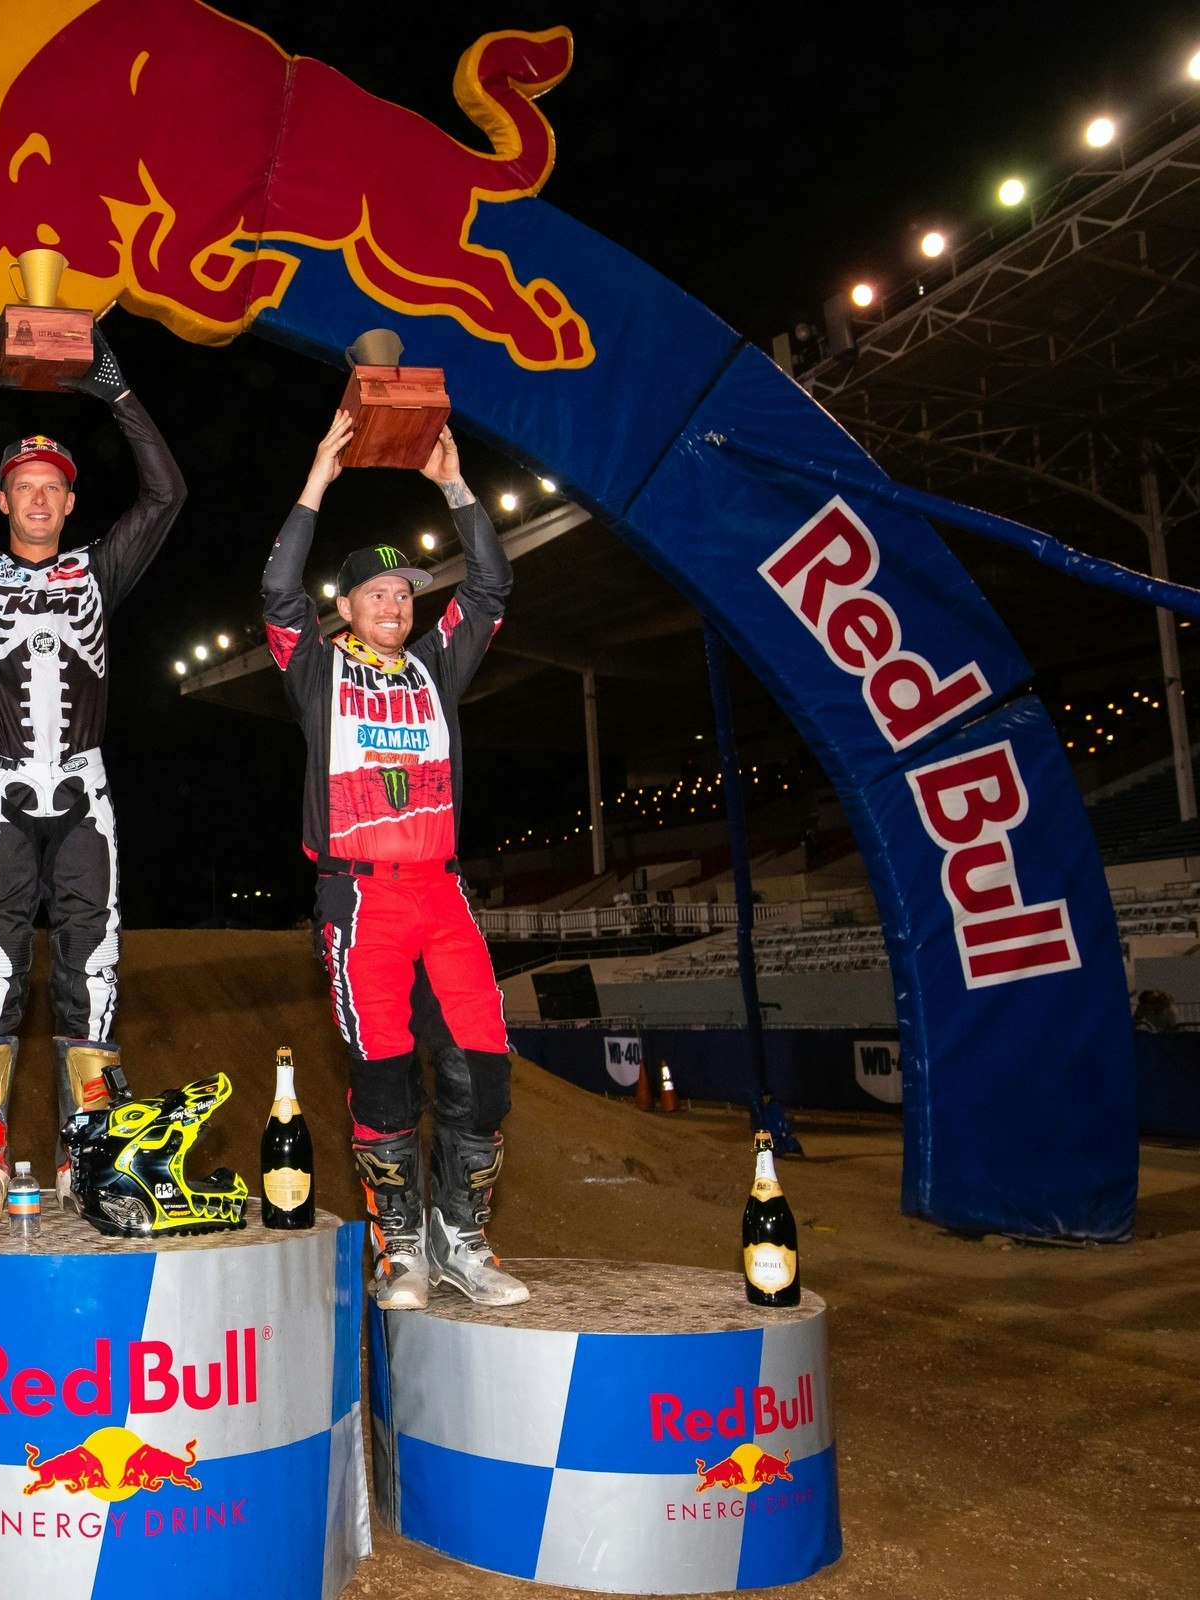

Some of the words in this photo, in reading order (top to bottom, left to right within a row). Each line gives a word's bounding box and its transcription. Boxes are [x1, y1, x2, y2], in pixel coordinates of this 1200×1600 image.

[762, 500, 987, 746] Red
[910, 742, 1076, 984] Bull
[608, 1042, 641, 1065] WD-40
[860, 1046, 902, 1076] WD-
[156, 1184, 172, 1195] PPG
[754, 1260, 784, 1269] KORBEL
[129, 1327, 258, 1414] Bull
[650, 1387, 746, 1441] Red
[753, 1374, 814, 1435] Bull
[146, 1498, 247, 1538] DRINK
[667, 1500, 759, 1521] ENERGY
[766, 1487, 814, 1514] DRINK
